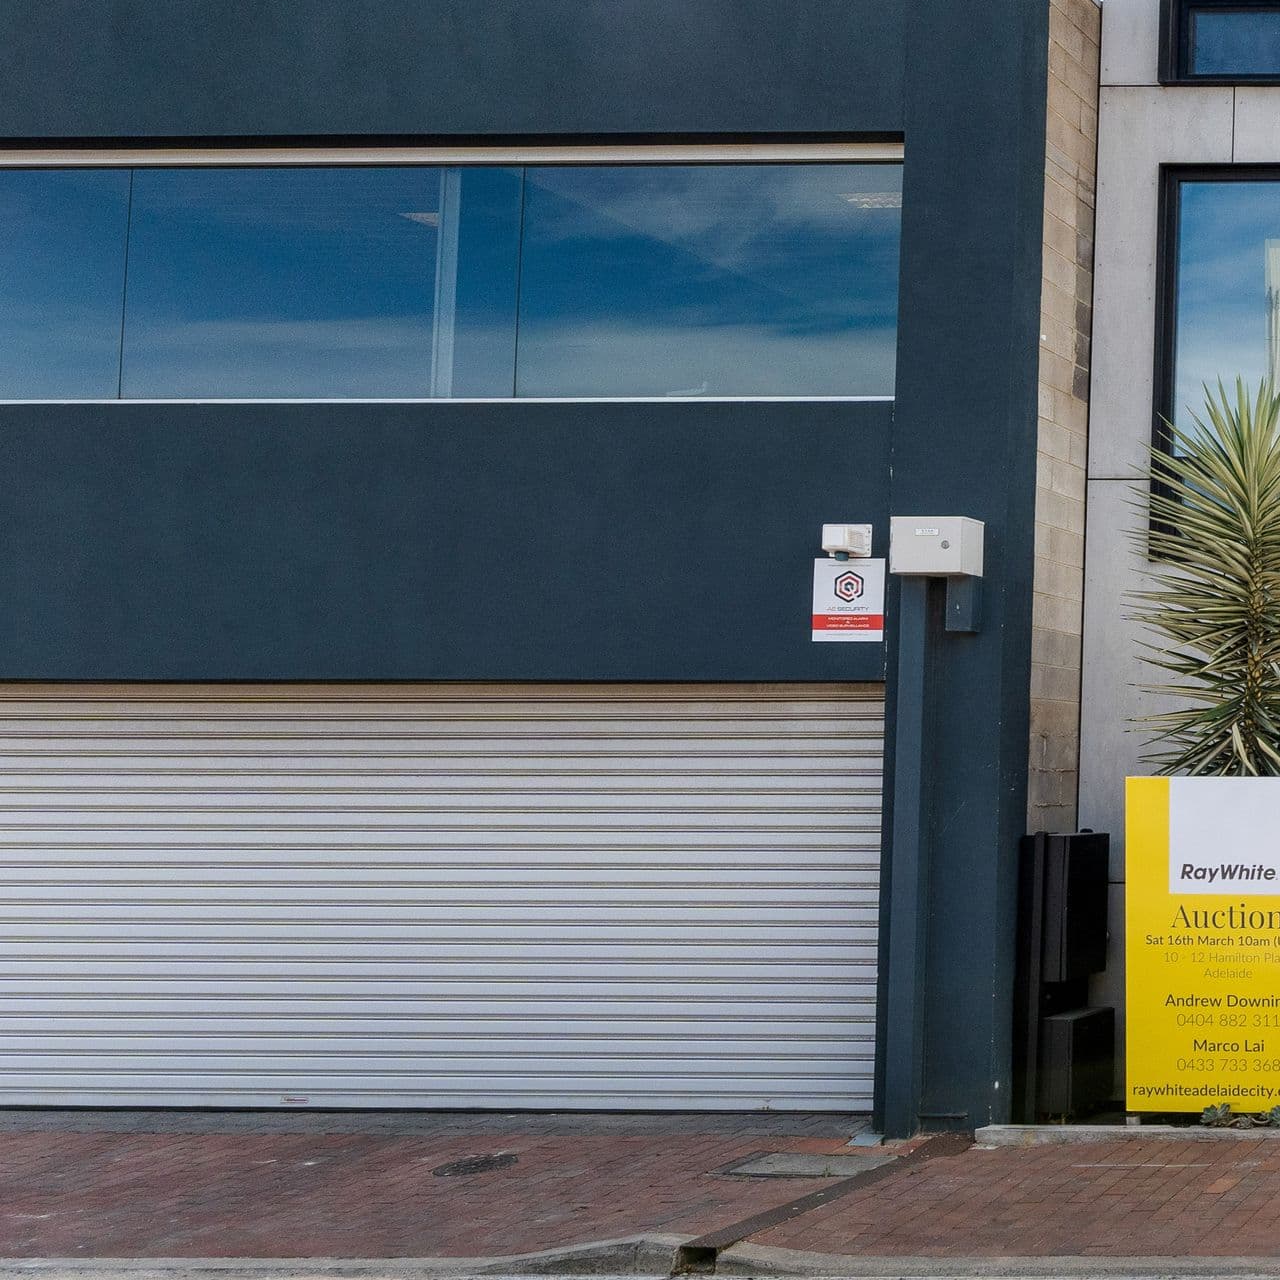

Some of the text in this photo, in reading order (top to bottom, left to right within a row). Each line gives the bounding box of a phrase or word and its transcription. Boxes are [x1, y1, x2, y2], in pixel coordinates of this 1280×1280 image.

[1180, 864, 1276, 883] RayWhite
[1146, 935, 1163, 945] Sat
[1168, 935, 1194, 946] 16th
[1197, 935, 1234, 946] March
[1238, 936, 1270, 947] 10am
[1164, 952, 1178, 963] 10
[1191, 952, 1205, 963] 12
[1209, 952, 1260, 963] Hamilton
[1203, 968, 1253, 979] Adelaide
[1165, 994, 1222, 1007] Andrew
[1177, 1014, 1280, 1027] 0404 882 311
[1193, 1039, 1265, 1052] Marco Lai
[1177, 1058, 1280, 1072] 0433 733 368
